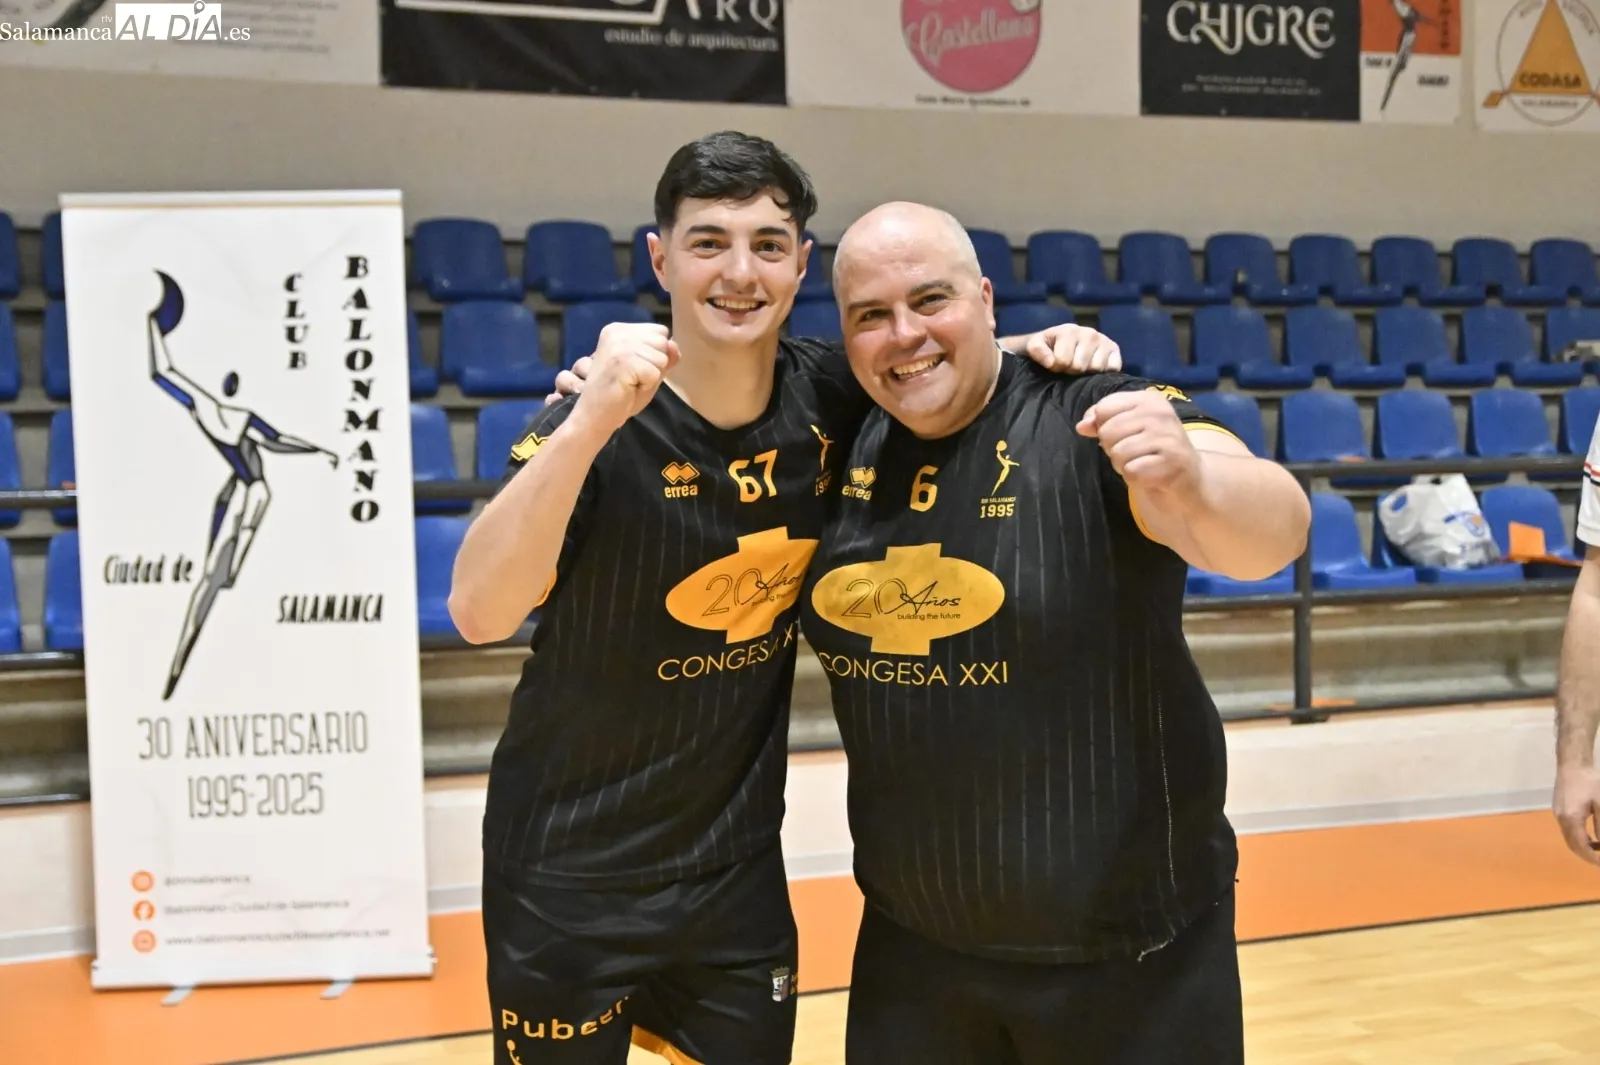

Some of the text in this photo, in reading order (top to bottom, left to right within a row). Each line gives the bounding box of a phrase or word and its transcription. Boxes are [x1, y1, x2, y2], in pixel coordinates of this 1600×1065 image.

[284, 273, 309, 370] CLUB
[342, 255, 382, 523] BALONMANO
[664, 484, 698, 499] errea
[728, 449, 778, 503] 67
[909, 464, 939, 512] 6
[980, 503, 1015, 519] 1995
[104, 555, 193, 585] Ciudad de
[277, 594, 384, 624] SALAMANCA
[701, 567, 764, 616] 20
[841, 578, 962, 618] 20 Años
[897, 612, 925, 621] building
[657, 637, 779, 681] CONGESA
[819, 652, 1008, 686] CONGESA XXI
[137, 711, 369, 760] 30 ANIVERSARIO
